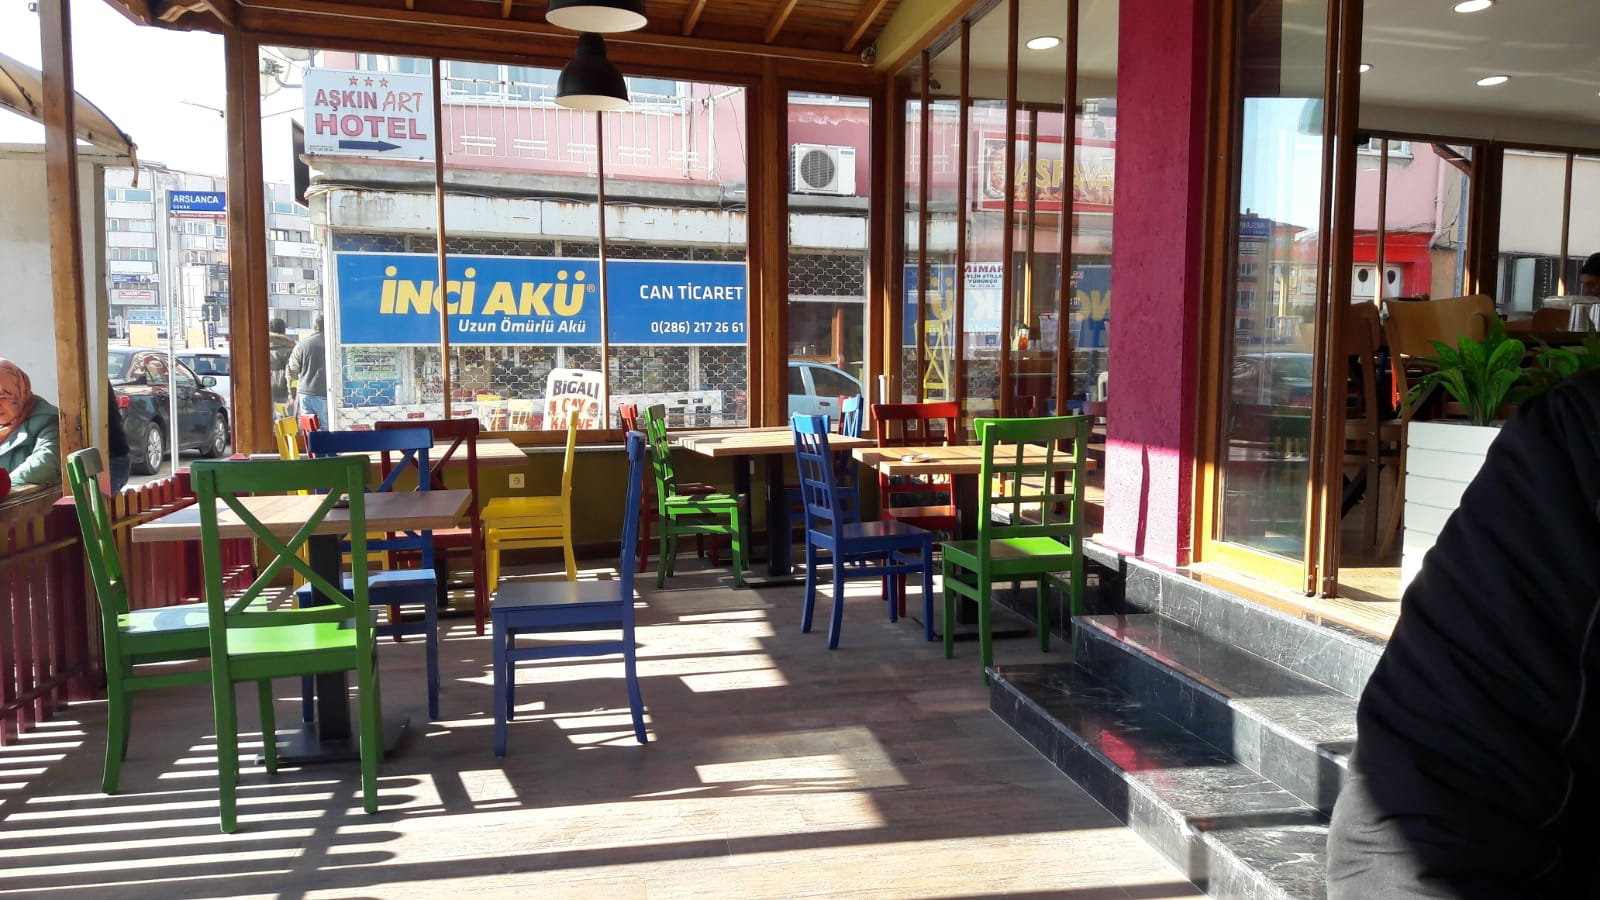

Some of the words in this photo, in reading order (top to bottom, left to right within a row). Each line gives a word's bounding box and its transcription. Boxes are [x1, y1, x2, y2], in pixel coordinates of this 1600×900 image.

[314, 88, 378, 112] AŞKIN
[382, 90, 424, 113] ART
[315, 113, 427, 140] HOTEL
[173, 194, 219, 204] ARSLANCA
[379, 265, 476, 315] İNCİ
[481, 270, 586, 316] AKÜ
[639, 284, 674, 300] CAN
[677, 281, 744, 300] TİCARET
[458, 319, 496, 333] Uzun
[500, 316, 554, 333] Ömürlü
[558, 320, 586, 333] Akü
[651, 321, 690, 335] 0(286)
[694, 322, 712, 333] 217
[715, 322, 729, 333] 26
[732, 322, 744, 333] 61
